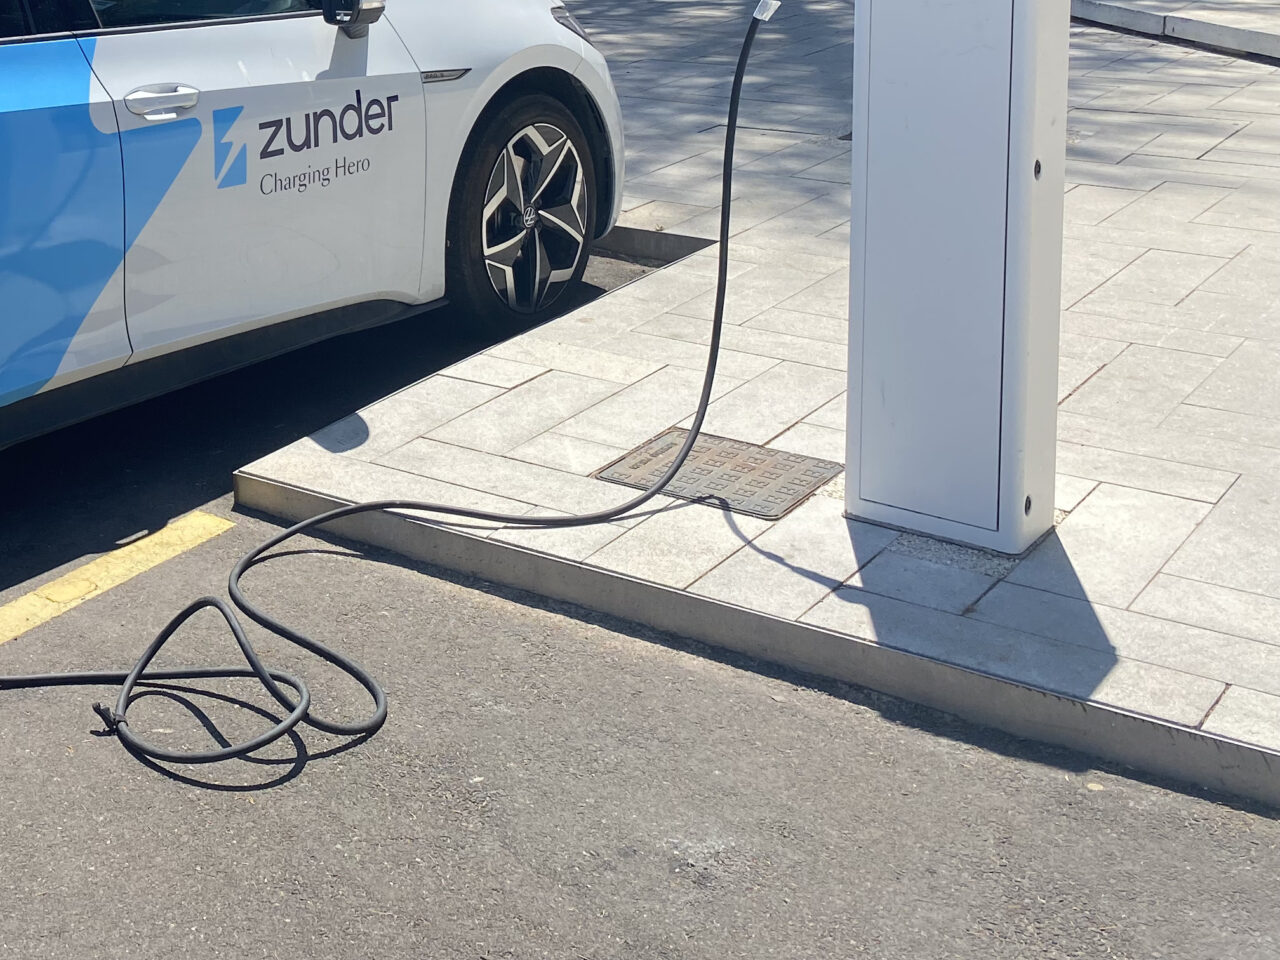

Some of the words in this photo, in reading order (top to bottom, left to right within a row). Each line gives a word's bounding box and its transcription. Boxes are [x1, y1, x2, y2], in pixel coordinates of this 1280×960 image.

[258, 89, 399, 160] zunder
[259, 165, 332, 196] Charging
[334, 156, 370, 179] Hero
